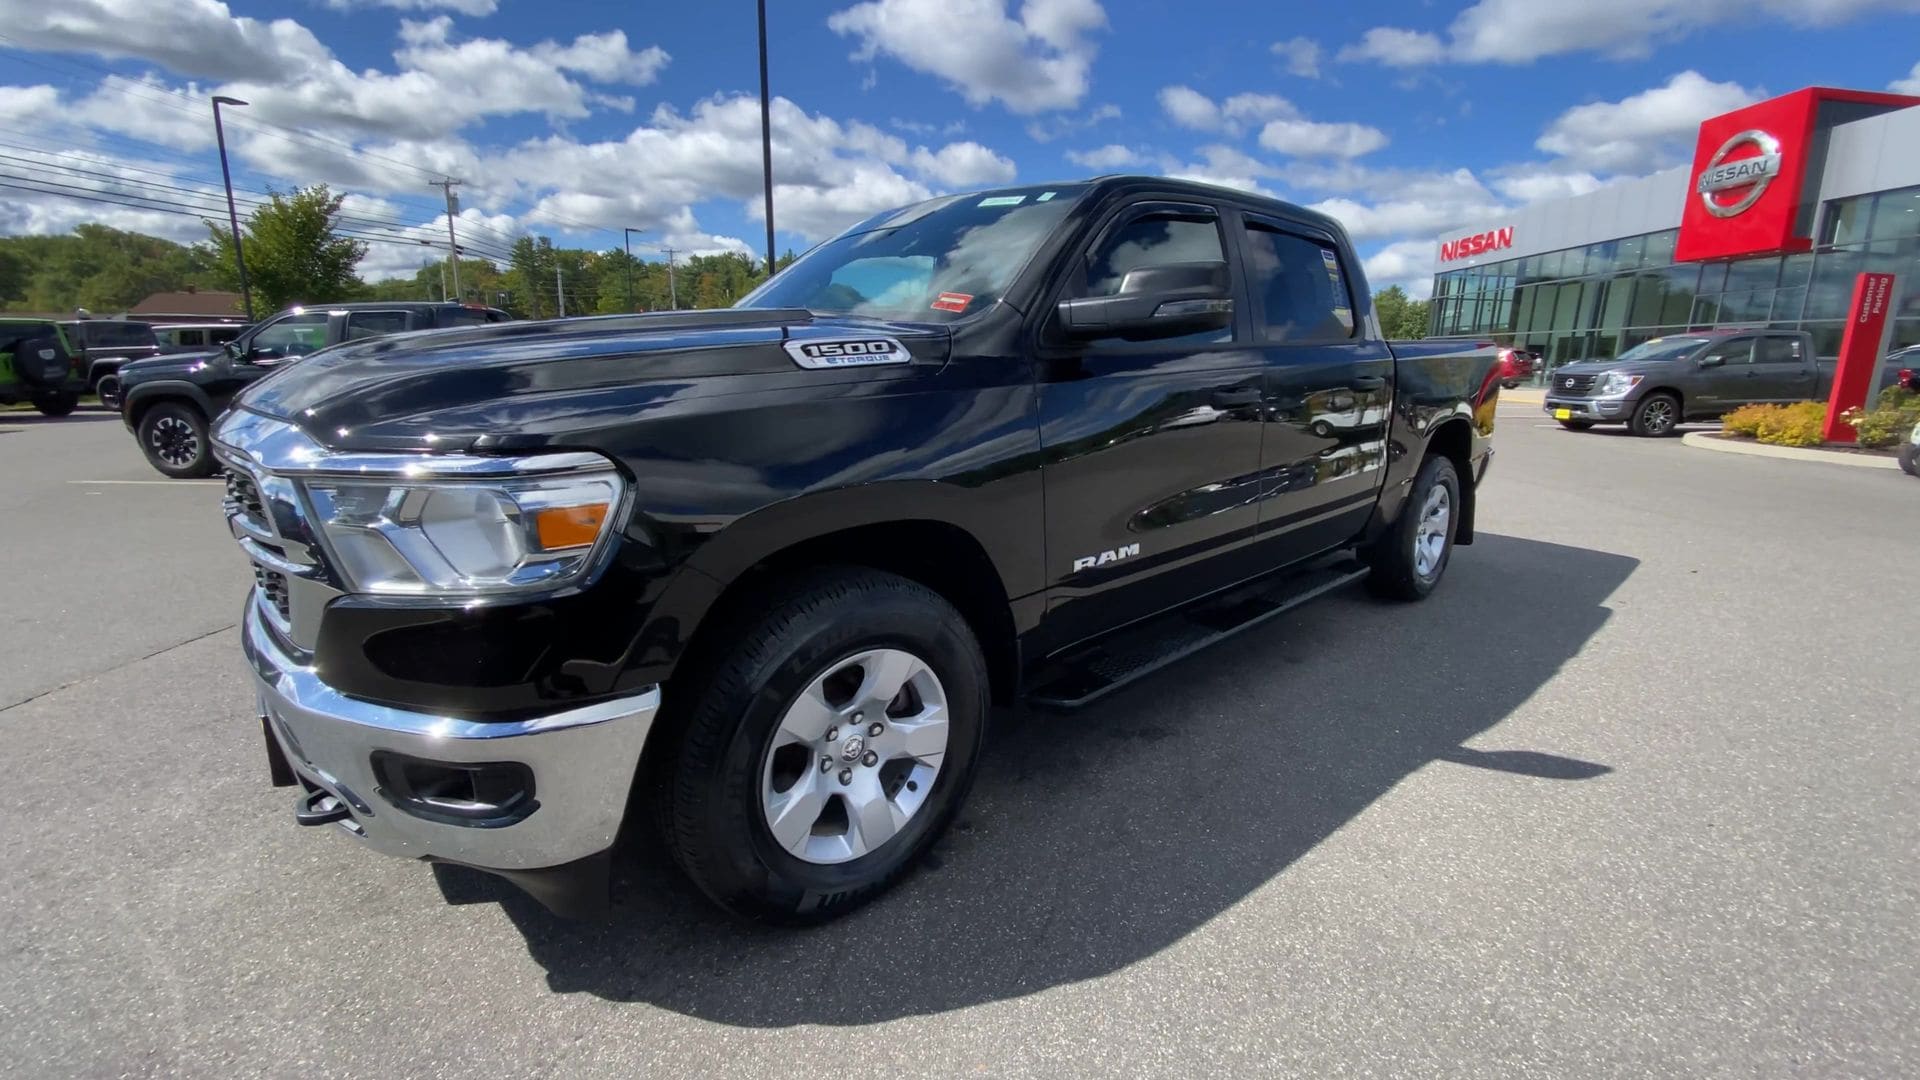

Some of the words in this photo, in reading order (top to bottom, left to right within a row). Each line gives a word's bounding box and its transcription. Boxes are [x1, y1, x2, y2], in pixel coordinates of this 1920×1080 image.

[1702, 159, 1768, 186] NISSAN
[1440, 226, 1513, 261] NISSAN
[1860, 277, 1876, 323] Customer
[1872, 277, 1889, 314] Parking
[806, 341, 890, 357] 1500
[1073, 543, 1140, 573] RAM
